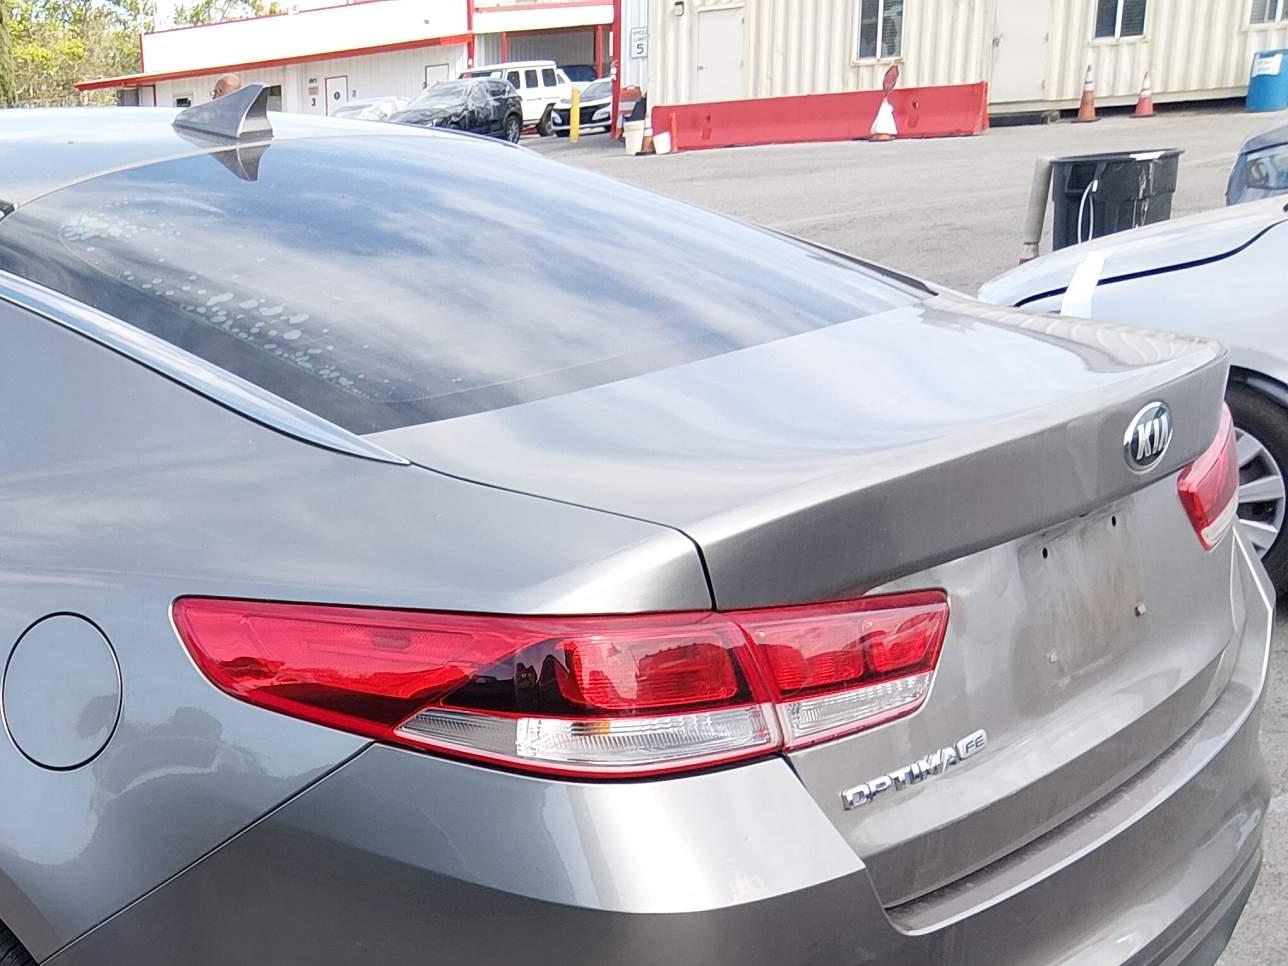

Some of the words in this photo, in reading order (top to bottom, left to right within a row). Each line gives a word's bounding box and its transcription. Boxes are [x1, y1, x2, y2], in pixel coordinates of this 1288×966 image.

[636, 43, 644, 55] 5
[1136, 414, 1170, 461] KIA
[840, 746, 958, 811] OPTIMA
